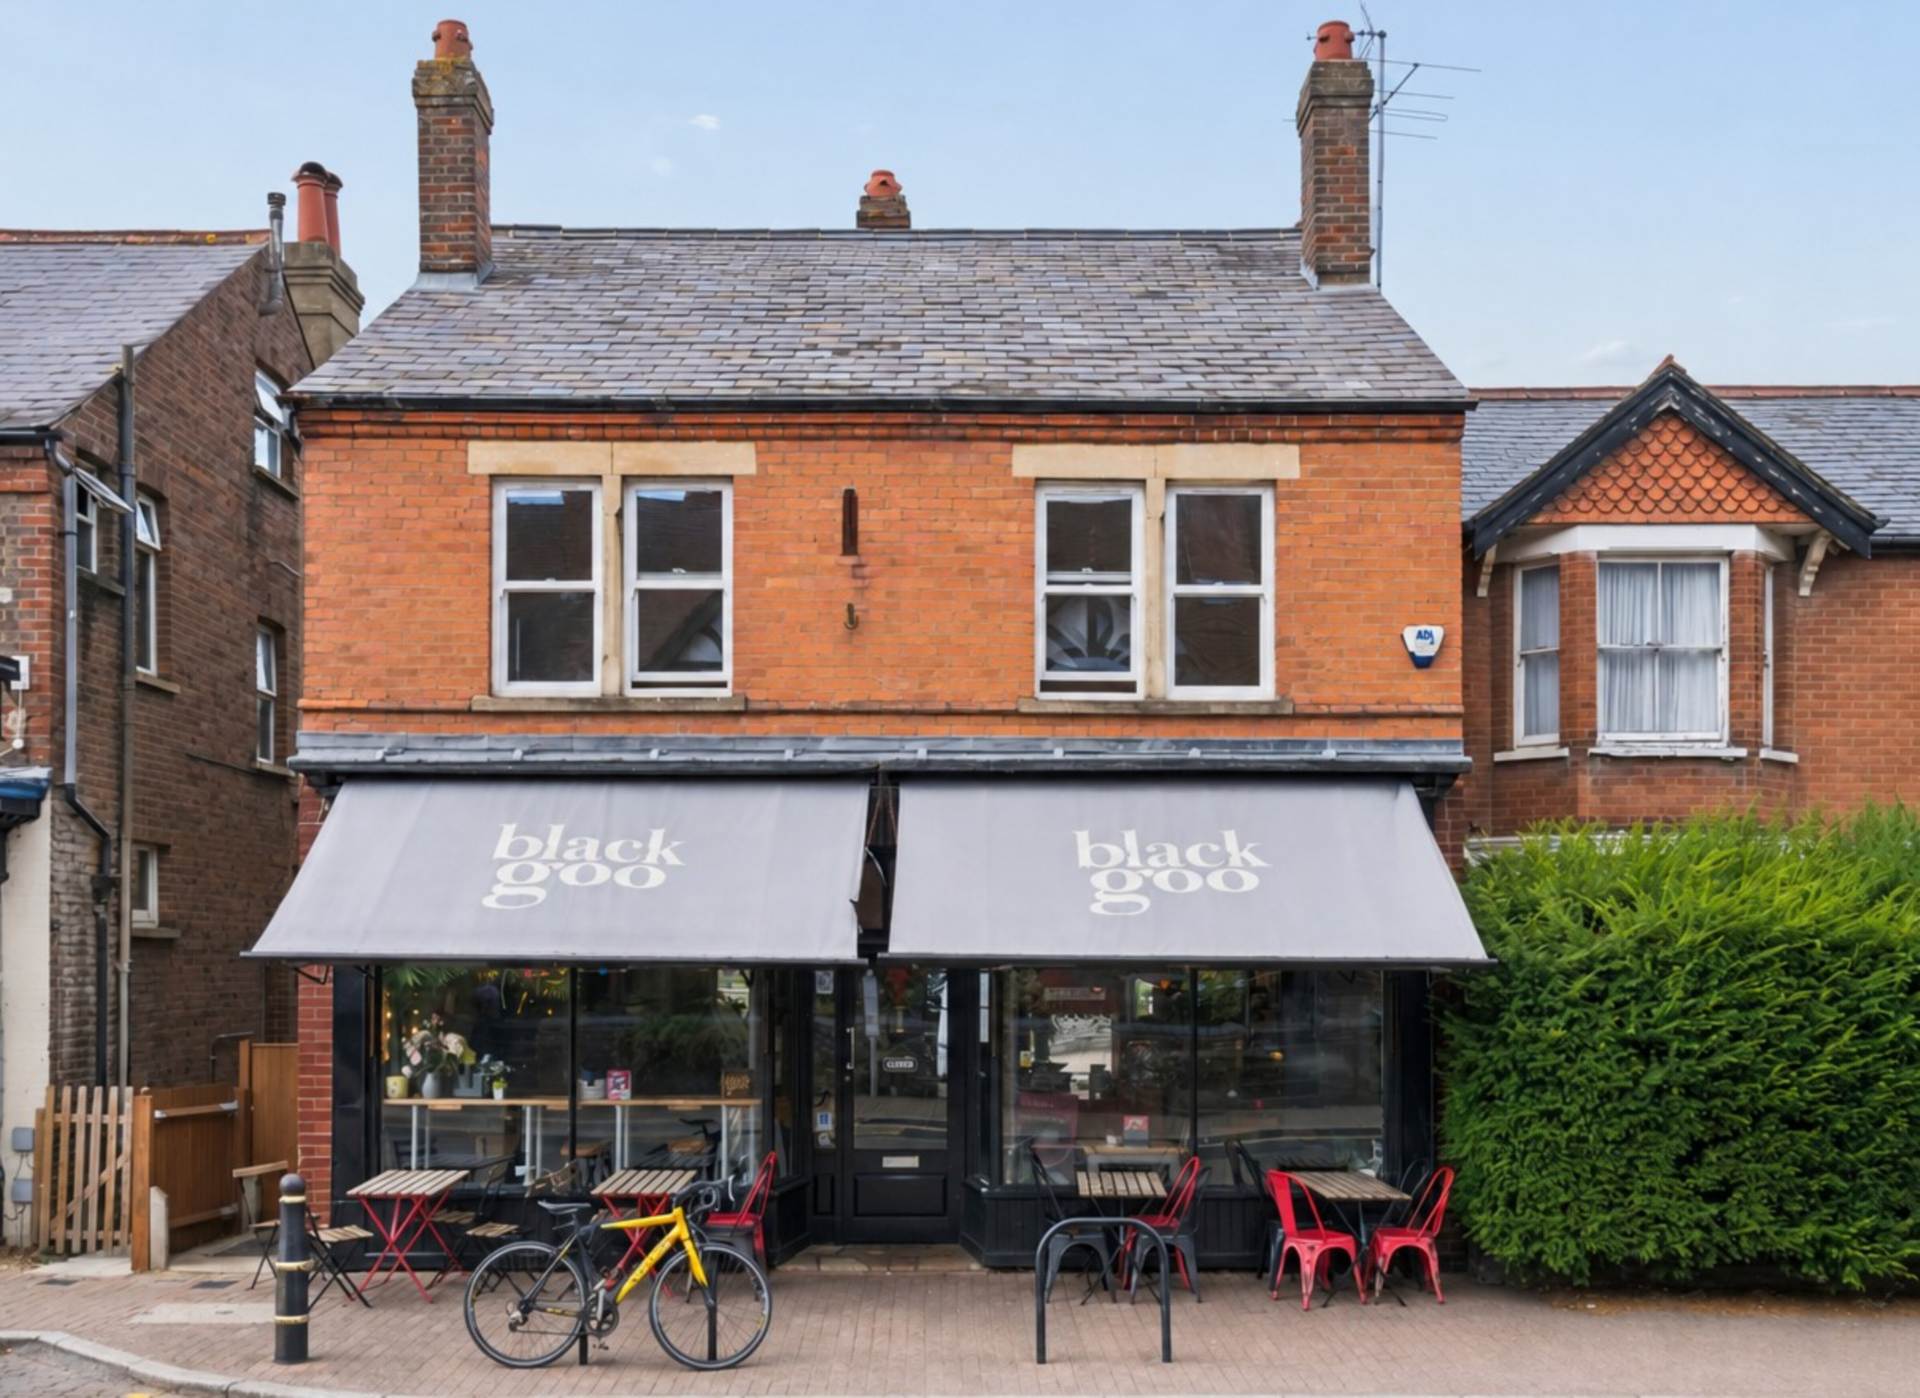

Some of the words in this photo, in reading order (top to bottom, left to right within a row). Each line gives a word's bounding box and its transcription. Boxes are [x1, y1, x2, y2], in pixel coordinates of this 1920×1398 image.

[493, 823, 687, 866] black
[1072, 829, 1273, 868] black
[481, 861, 667, 909] goo
[1089, 868, 1260, 915] goo
